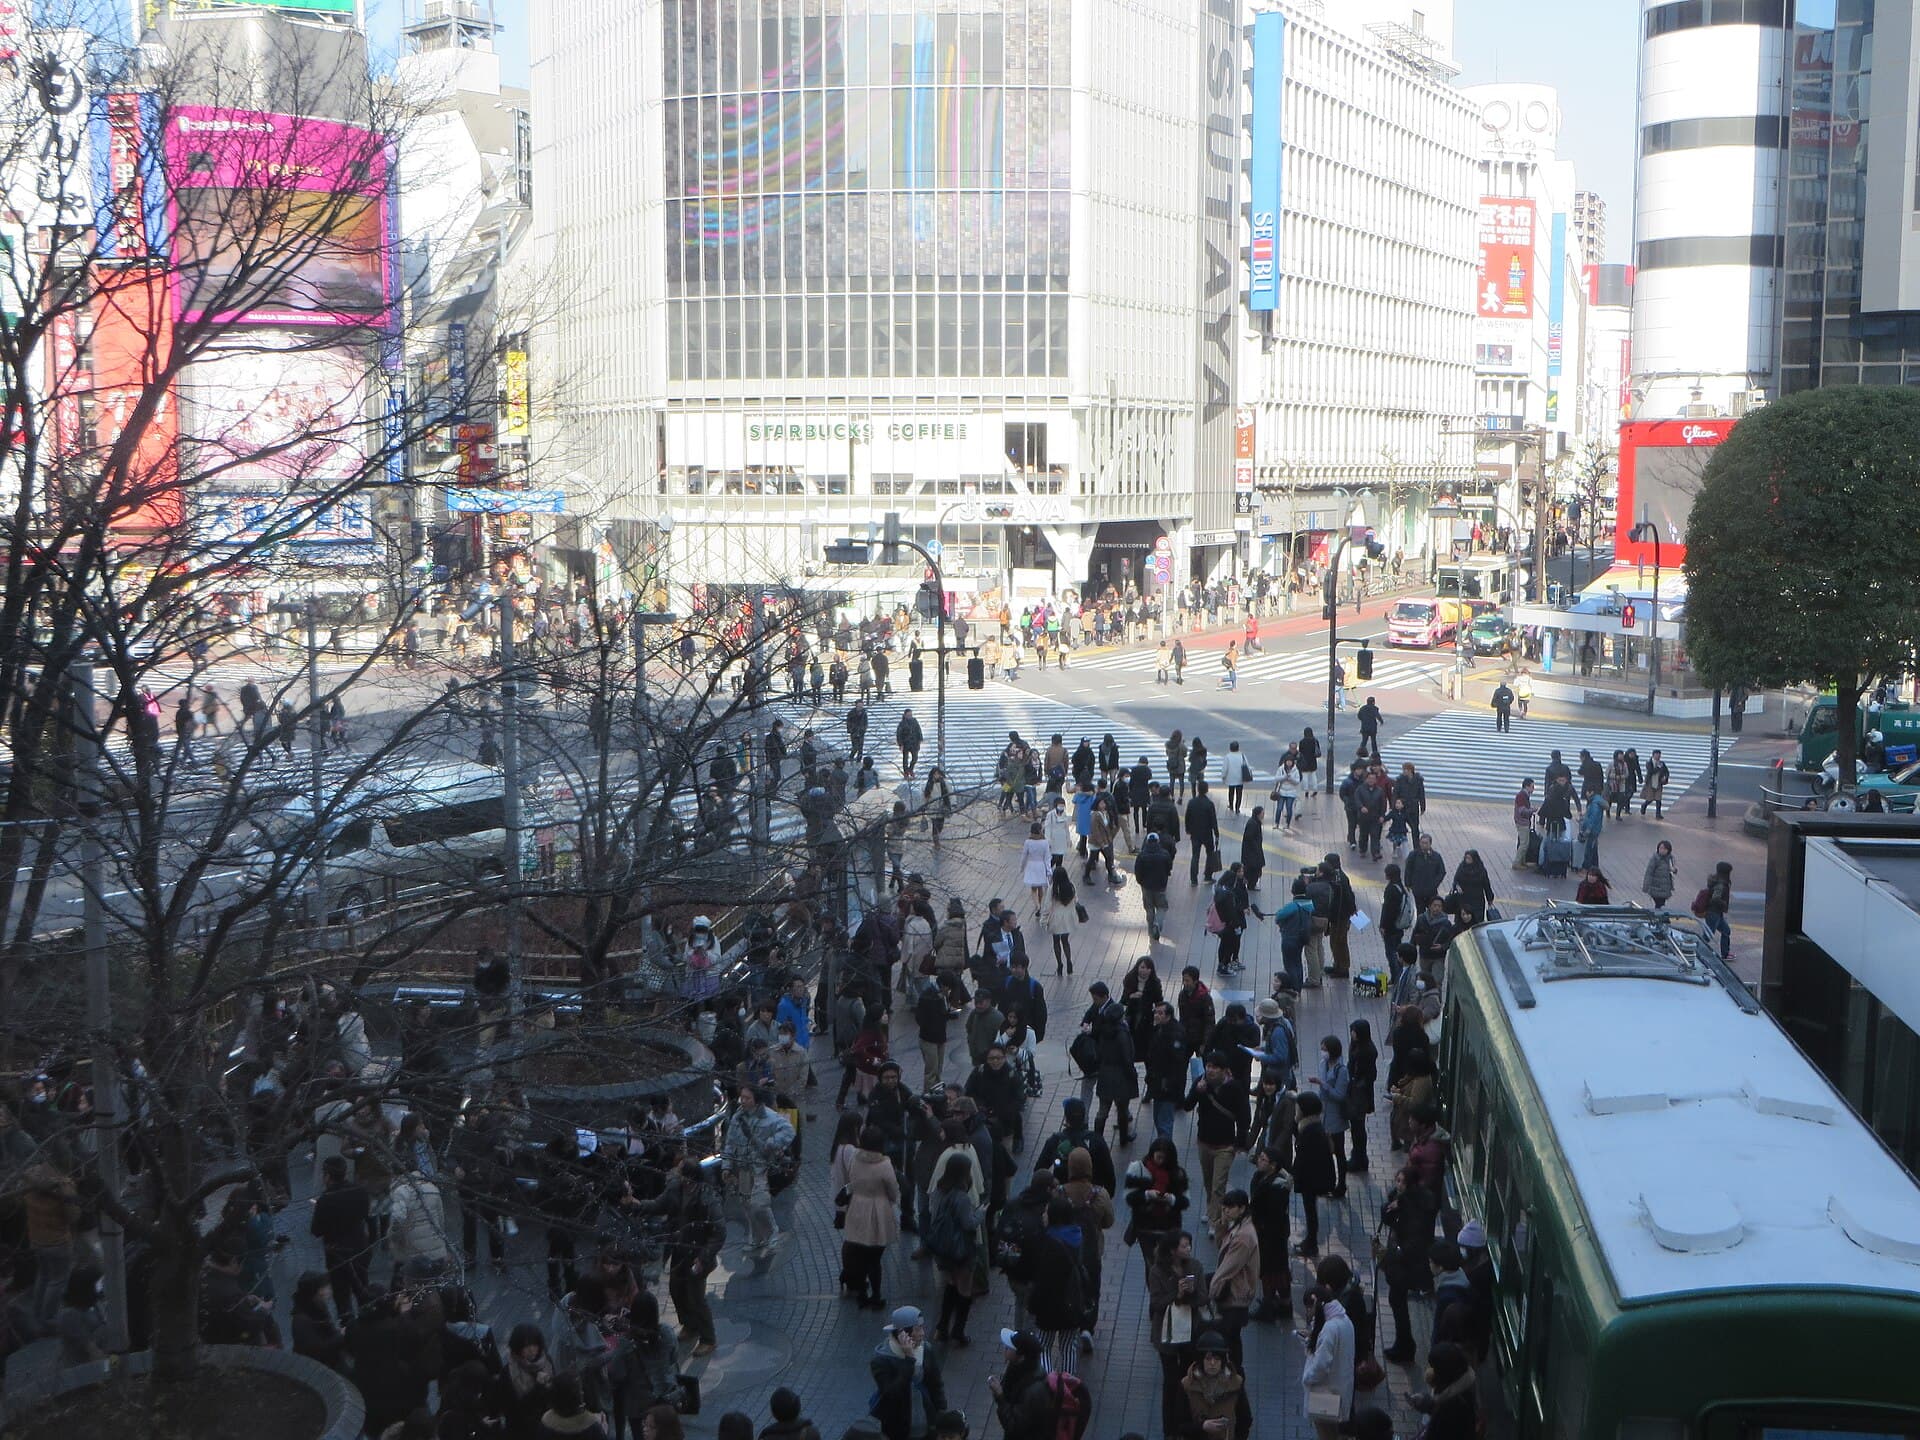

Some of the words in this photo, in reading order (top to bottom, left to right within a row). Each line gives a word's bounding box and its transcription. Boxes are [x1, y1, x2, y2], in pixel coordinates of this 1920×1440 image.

[1253, 211, 1274, 294] SEIBU
[1549, 322, 1561, 367] SEIBU
[750, 423, 873, 441] STARBUCKS
[888, 423, 967, 441] COFFEE
[1682, 425, 1718, 443] Glico
